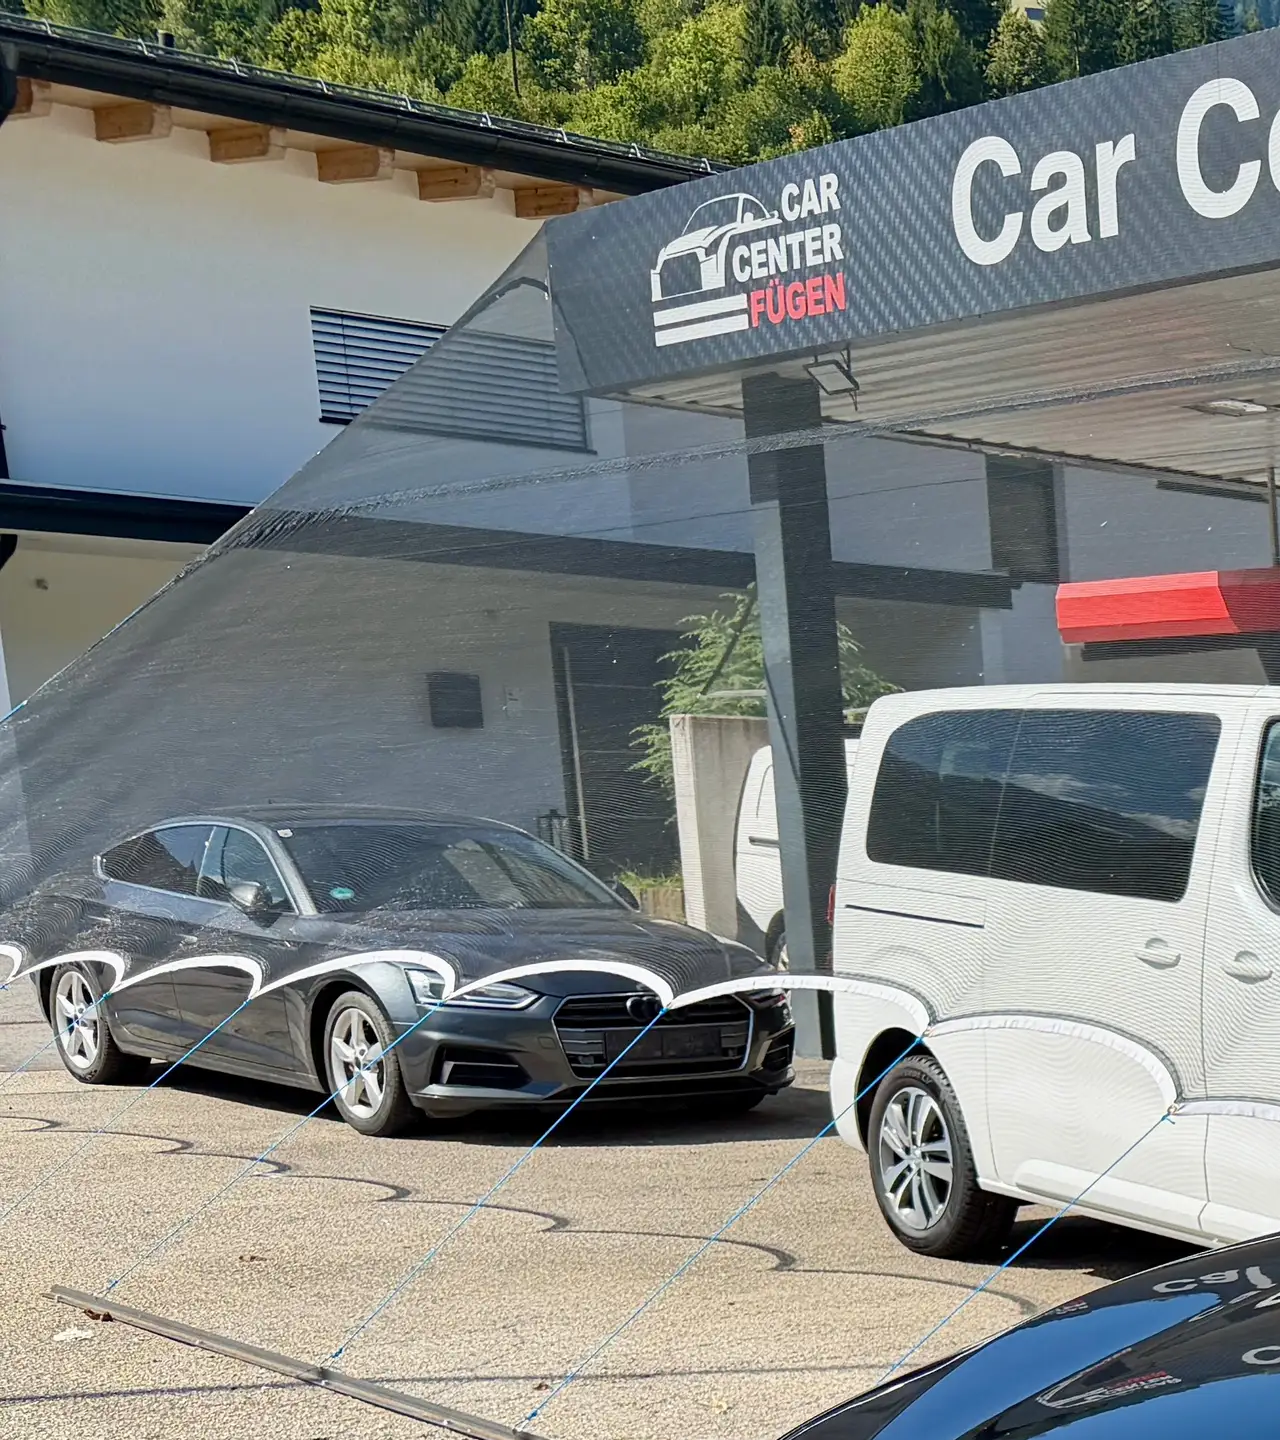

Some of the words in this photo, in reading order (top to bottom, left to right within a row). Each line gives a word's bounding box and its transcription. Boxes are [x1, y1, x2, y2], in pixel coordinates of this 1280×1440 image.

[780, 172, 842, 223] CAR
[950, 131, 1137, 267] Car
[731, 223, 844, 284] CENTER
[749, 272, 847, 330] FÜGEN
